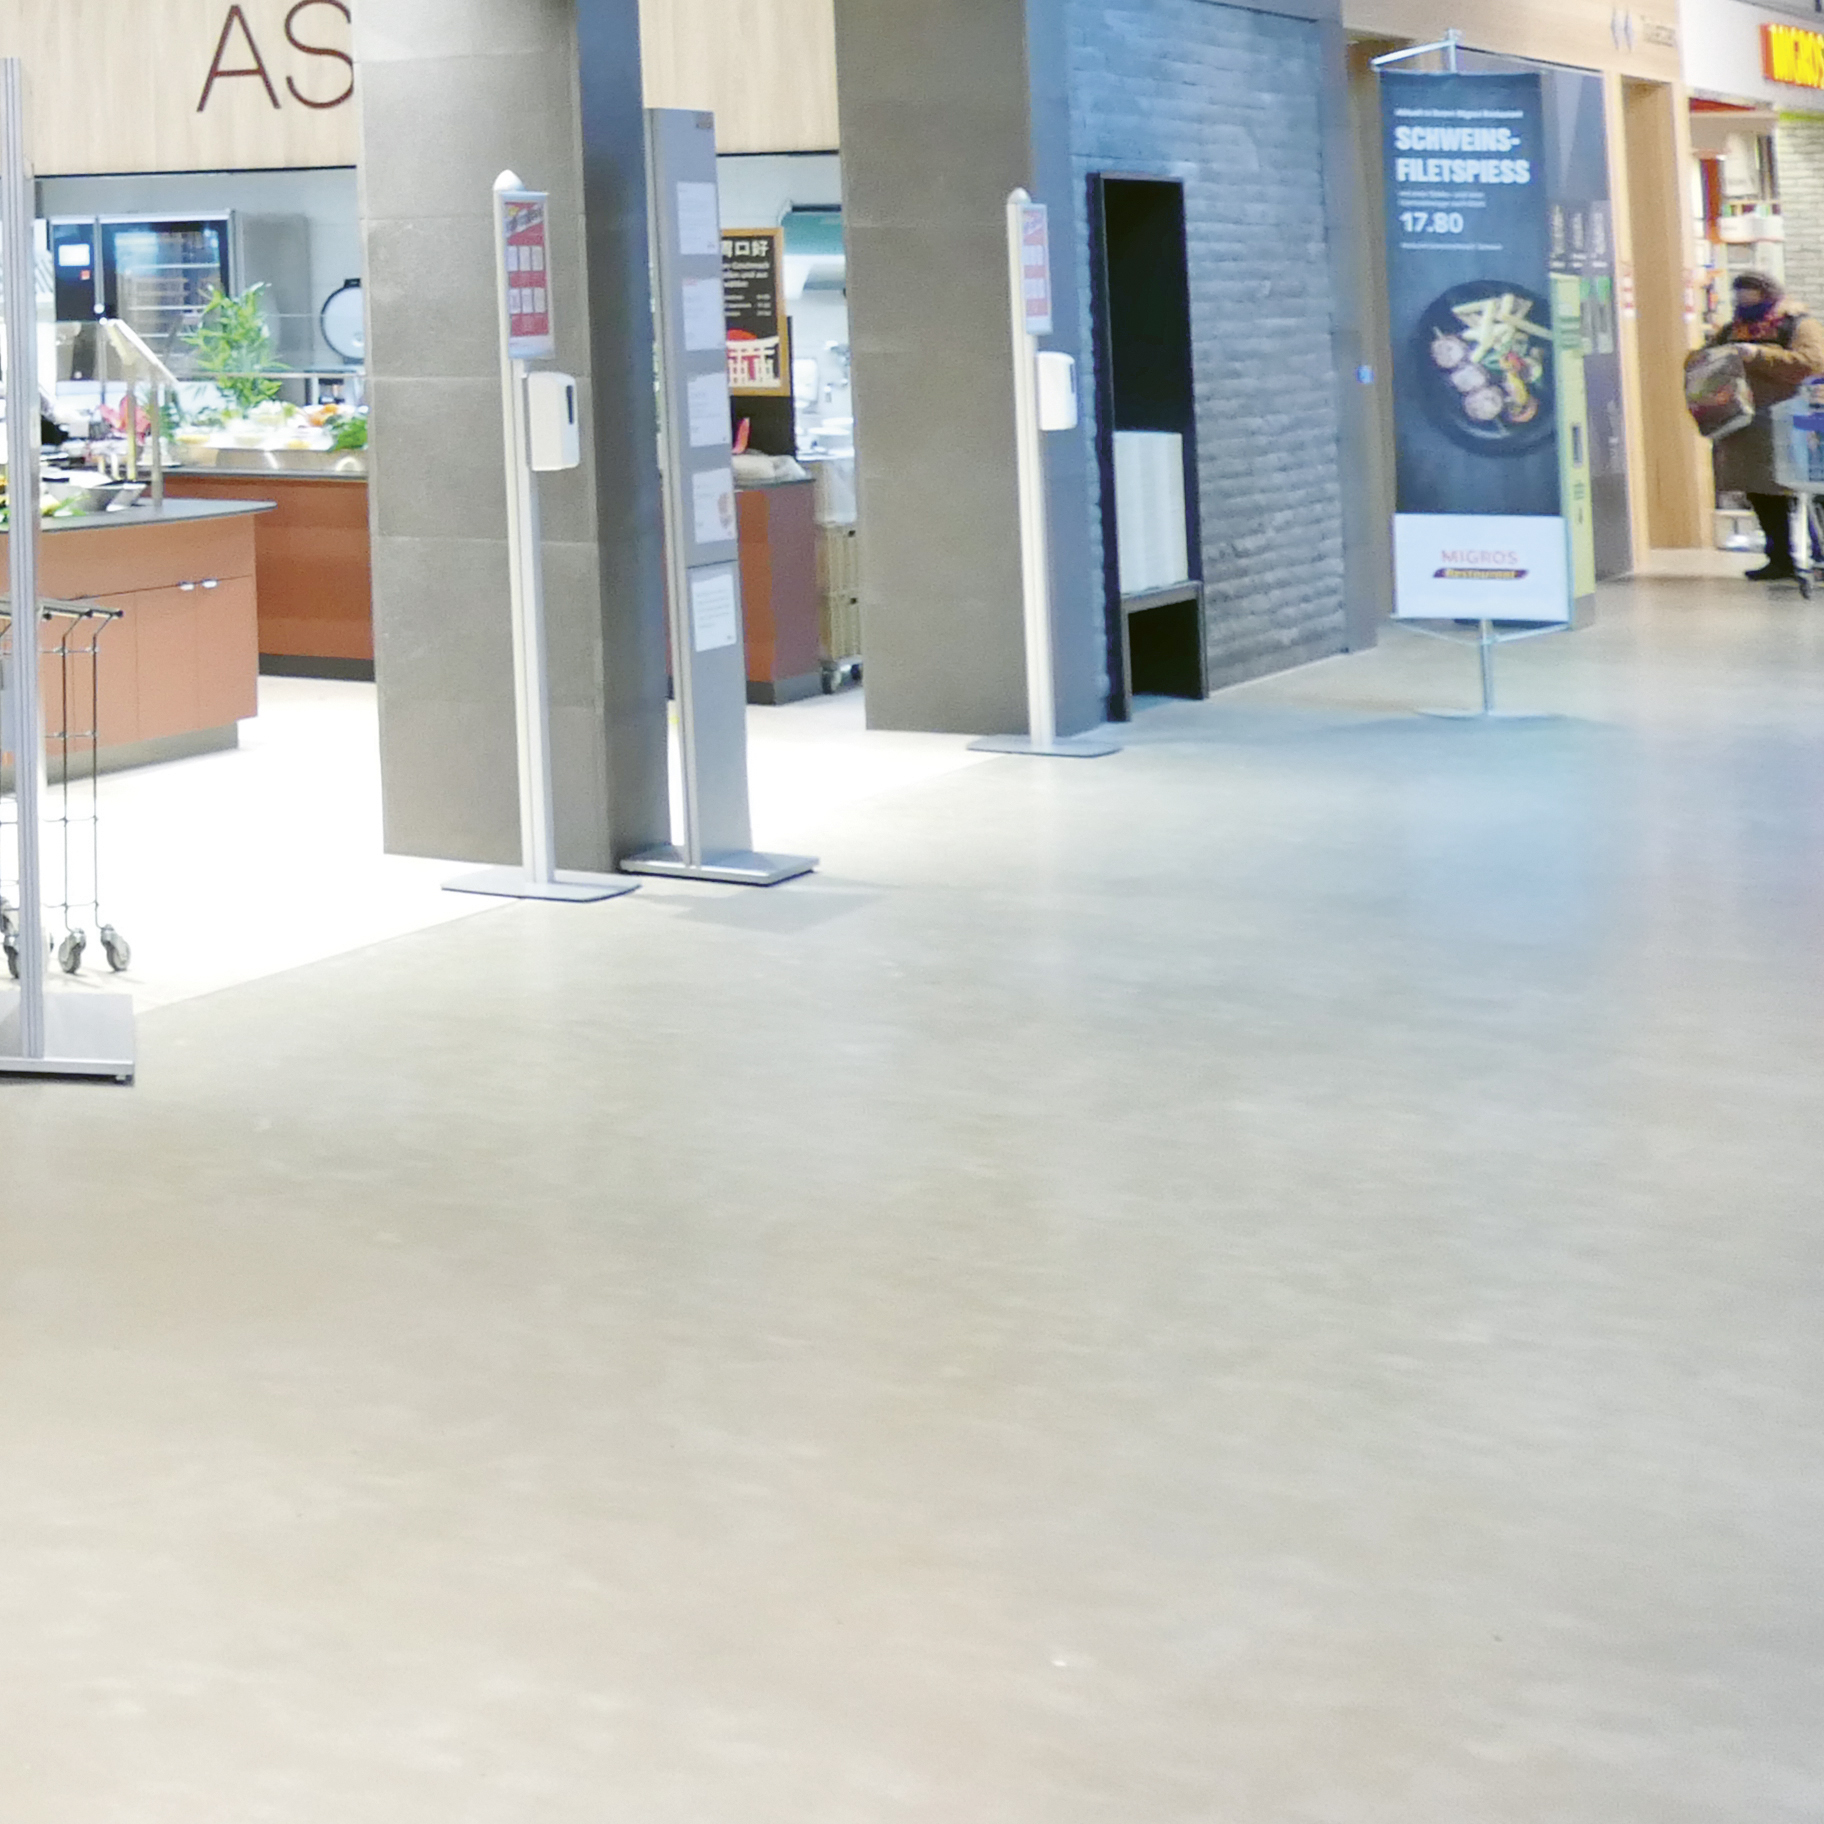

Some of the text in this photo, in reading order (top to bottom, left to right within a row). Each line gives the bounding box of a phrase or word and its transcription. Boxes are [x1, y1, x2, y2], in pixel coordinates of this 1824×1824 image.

[1394, 125, 1521, 152] SCHWEINS-
[1395, 157, 1531, 184] FILETSPIESS
[1399, 211, 1465, 234] 17.80
[1440, 549, 1519, 565] MIGROS
